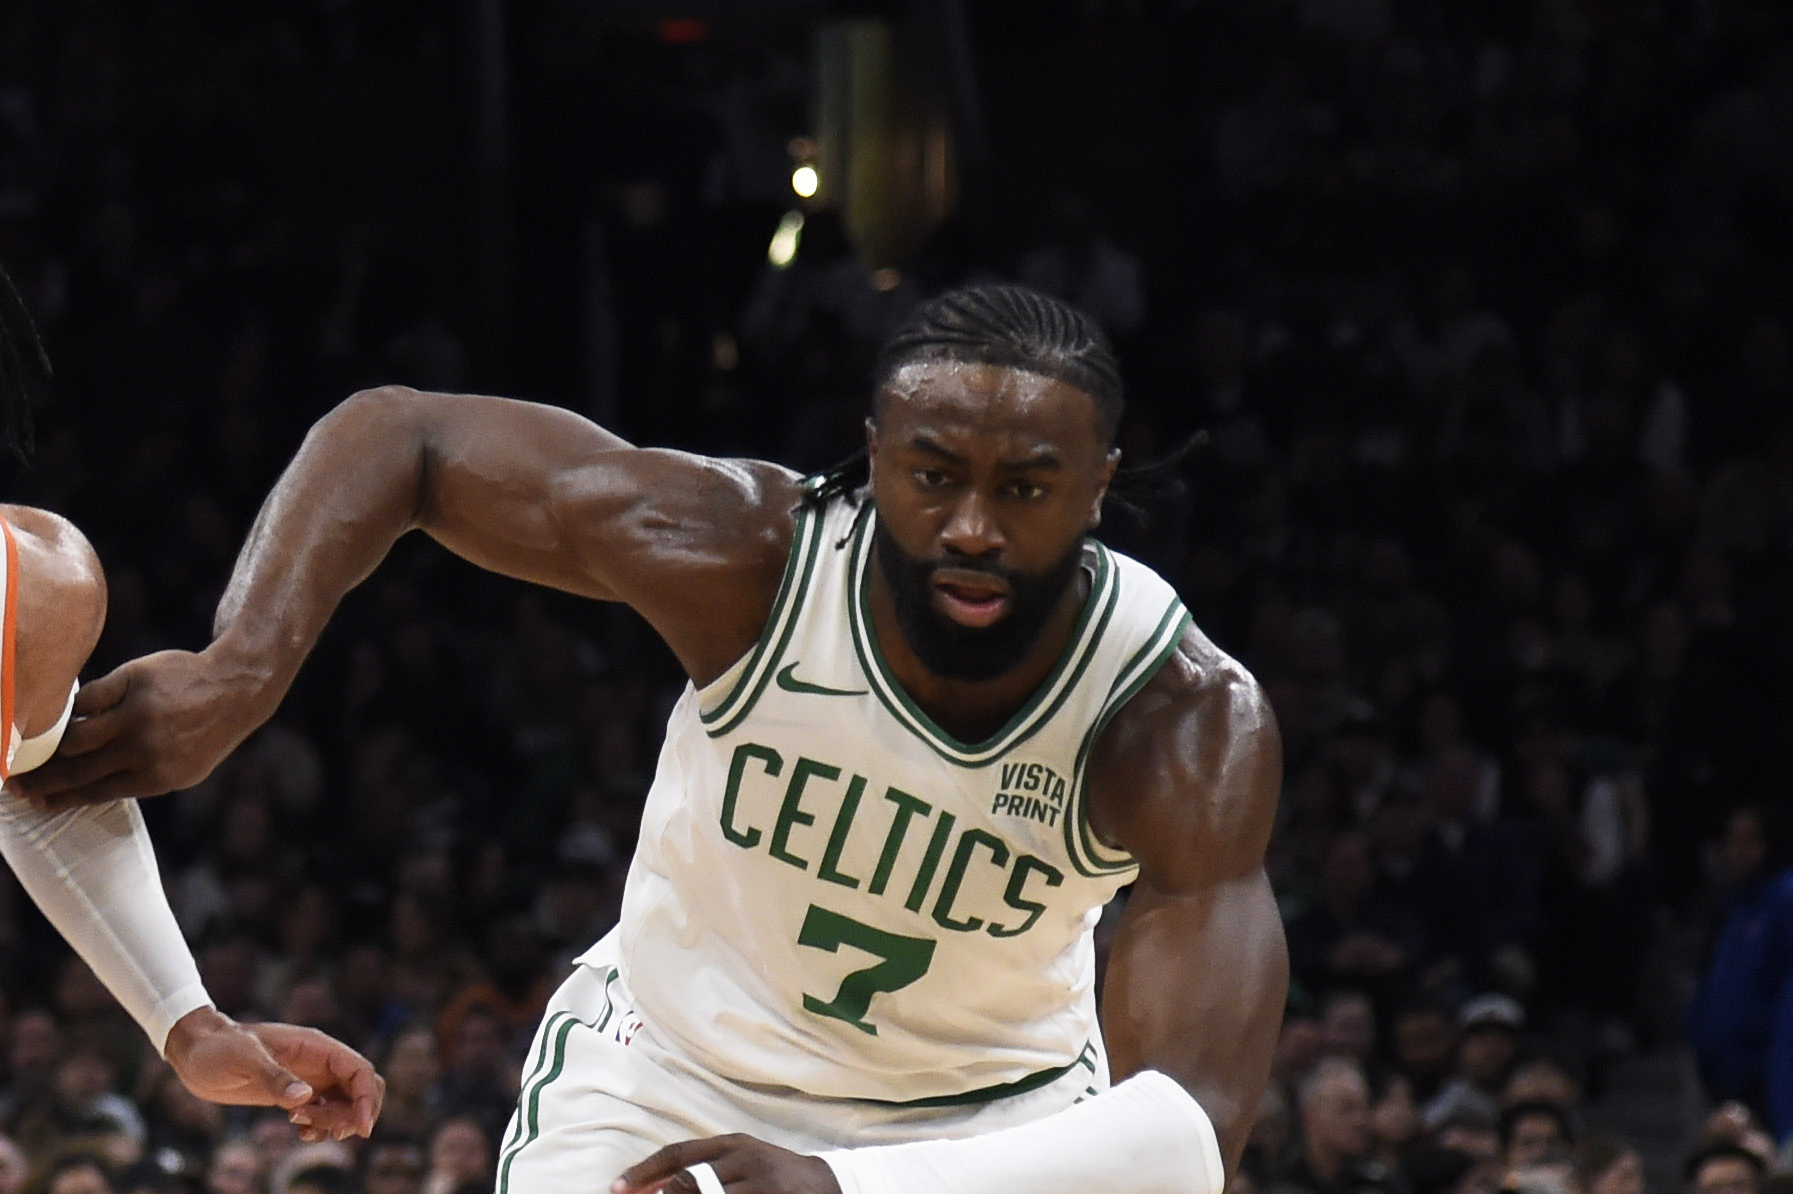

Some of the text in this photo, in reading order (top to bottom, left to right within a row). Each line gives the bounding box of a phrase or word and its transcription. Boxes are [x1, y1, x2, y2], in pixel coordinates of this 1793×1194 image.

[992, 793, 1062, 828] PRINT
[1001, 762, 1066, 802] VISTA
[719, 741, 1065, 938] CELTICS
[796, 903, 938, 1036] 7
